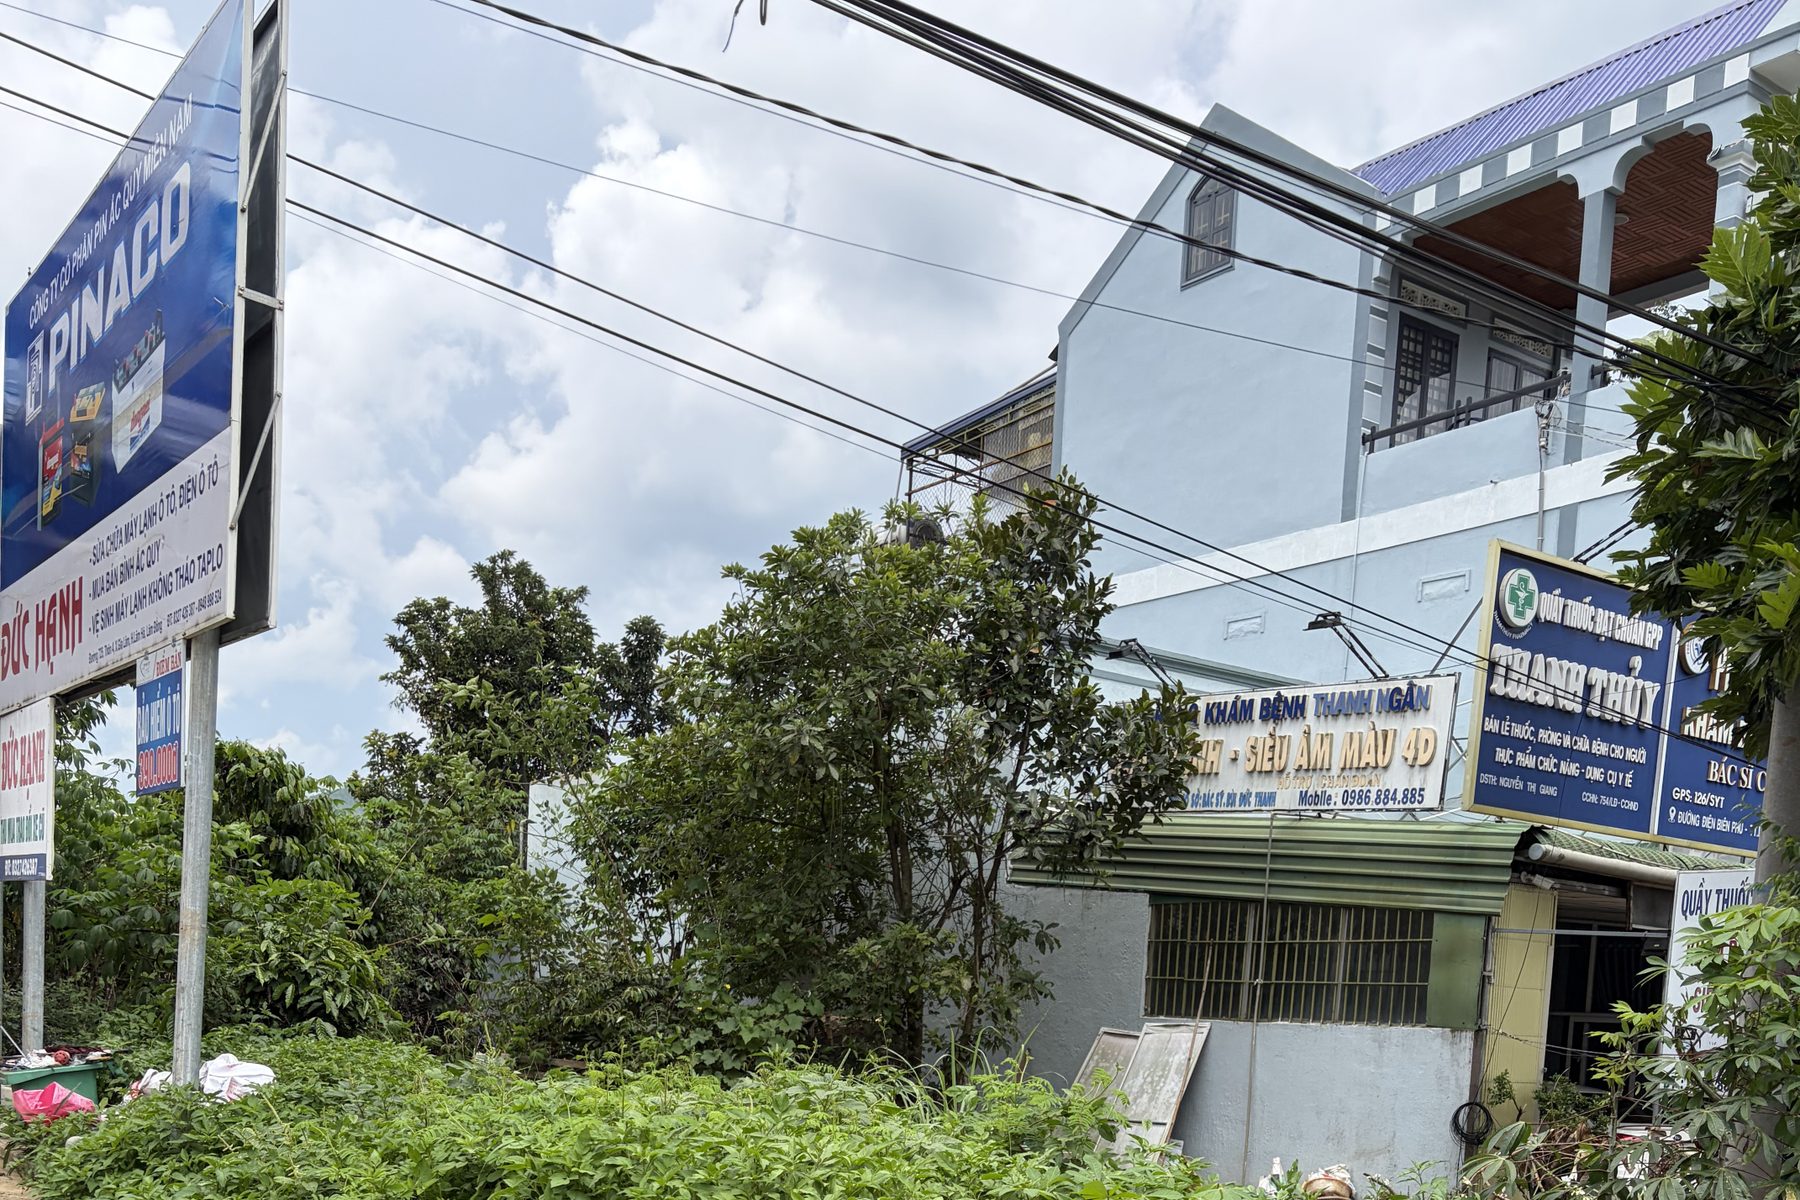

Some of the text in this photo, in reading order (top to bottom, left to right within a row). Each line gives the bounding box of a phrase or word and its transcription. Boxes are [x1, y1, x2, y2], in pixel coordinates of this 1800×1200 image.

[29, 288, 49, 330] CÔNG
[50, 274, 61, 305] TY
[71, 229, 93, 279] PHẦN
[94, 208, 108, 249] PIN
[122, 160, 143, 210] QUY
[143, 128, 167, 184] MIỀN
[168, 92, 193, 150] NAM
[48, 161, 190, 392] PINACO
[124, 513, 138, 546] MÁY
[139, 502, 157, 538] LẠNH
[159, 492, 164, 522] Ô
[179, 474, 197, 510] ĐIỆN
[199, 463, 205, 495] Ô
[207, 453, 218, 490] TÔ
[91, 609, 100, 638] VỆ
[100, 606, 115, 631] SINH
[115, 593, 129, 622] MÁY
[129, 586, 147, 619] LẠNH
[148, 571, 173, 606] KHÔNG
[174, 555, 196, 592] THÁO
[197, 543, 223, 580] TAPLO
[92, 575, 105, 601] MUA
[106, 563, 118, 593] BÁN
[146, 538, 160, 569] QUY
[1, 575, 83, 681] ĐỨC HẠNH
[1594, 608, 1616, 642] ĐẠT
[1644, 622, 1663, 650] GPP
[1204, 695, 1255, 724] KHÁM
[1259, 690, 1308, 724] BỆNH
[1313, 689, 1375, 717] THANH
[1376, 680, 1432, 712] NGÂN
[1489, 643, 1588, 714] THANH
[1586, 655, 1661, 729] THỦY
[1, 726, 45, 800] ĐỨC HẠNH
[1245, 726, 1291, 773] SIÊU
[1293, 724, 1333, 770] ÂM
[1339, 720, 1398, 769] MÀU
[1402, 727, 1438, 766] 4D
[1484, 714, 1647, 765] BÁN LẺ THUỐC, PHÒNG VÀ CHỮA BỆNH CHO NGƯỜI
[1495, 747, 1515, 769] THỰC
[1515, 746, 1537, 769] PHẨM
[1537, 753, 1558, 773] CHỨC
[1585, 765, 1605, 786] DỤNG
[1606, 769, 1618, 789] CỤ
[1618, 770, 1624, 785] Y
[1624, 769, 1635, 788] TẾ
[1527, 781, 1537, 795] THỊ
[1539, 784, 1558, 797] GIANG
[1707, 756, 1737, 786] BÁC
[1739, 764, 1754, 789] SĨ
[1672, 787, 1725, 809] GPS: 126/SYT
[1677, 810, 1700, 827] ĐƯỜNG
[1701, 813, 1716, 832] ĐIỆN
[1716, 817, 1731, 833] BIÊN
[1681, 877, 1712, 921] QUẦY
